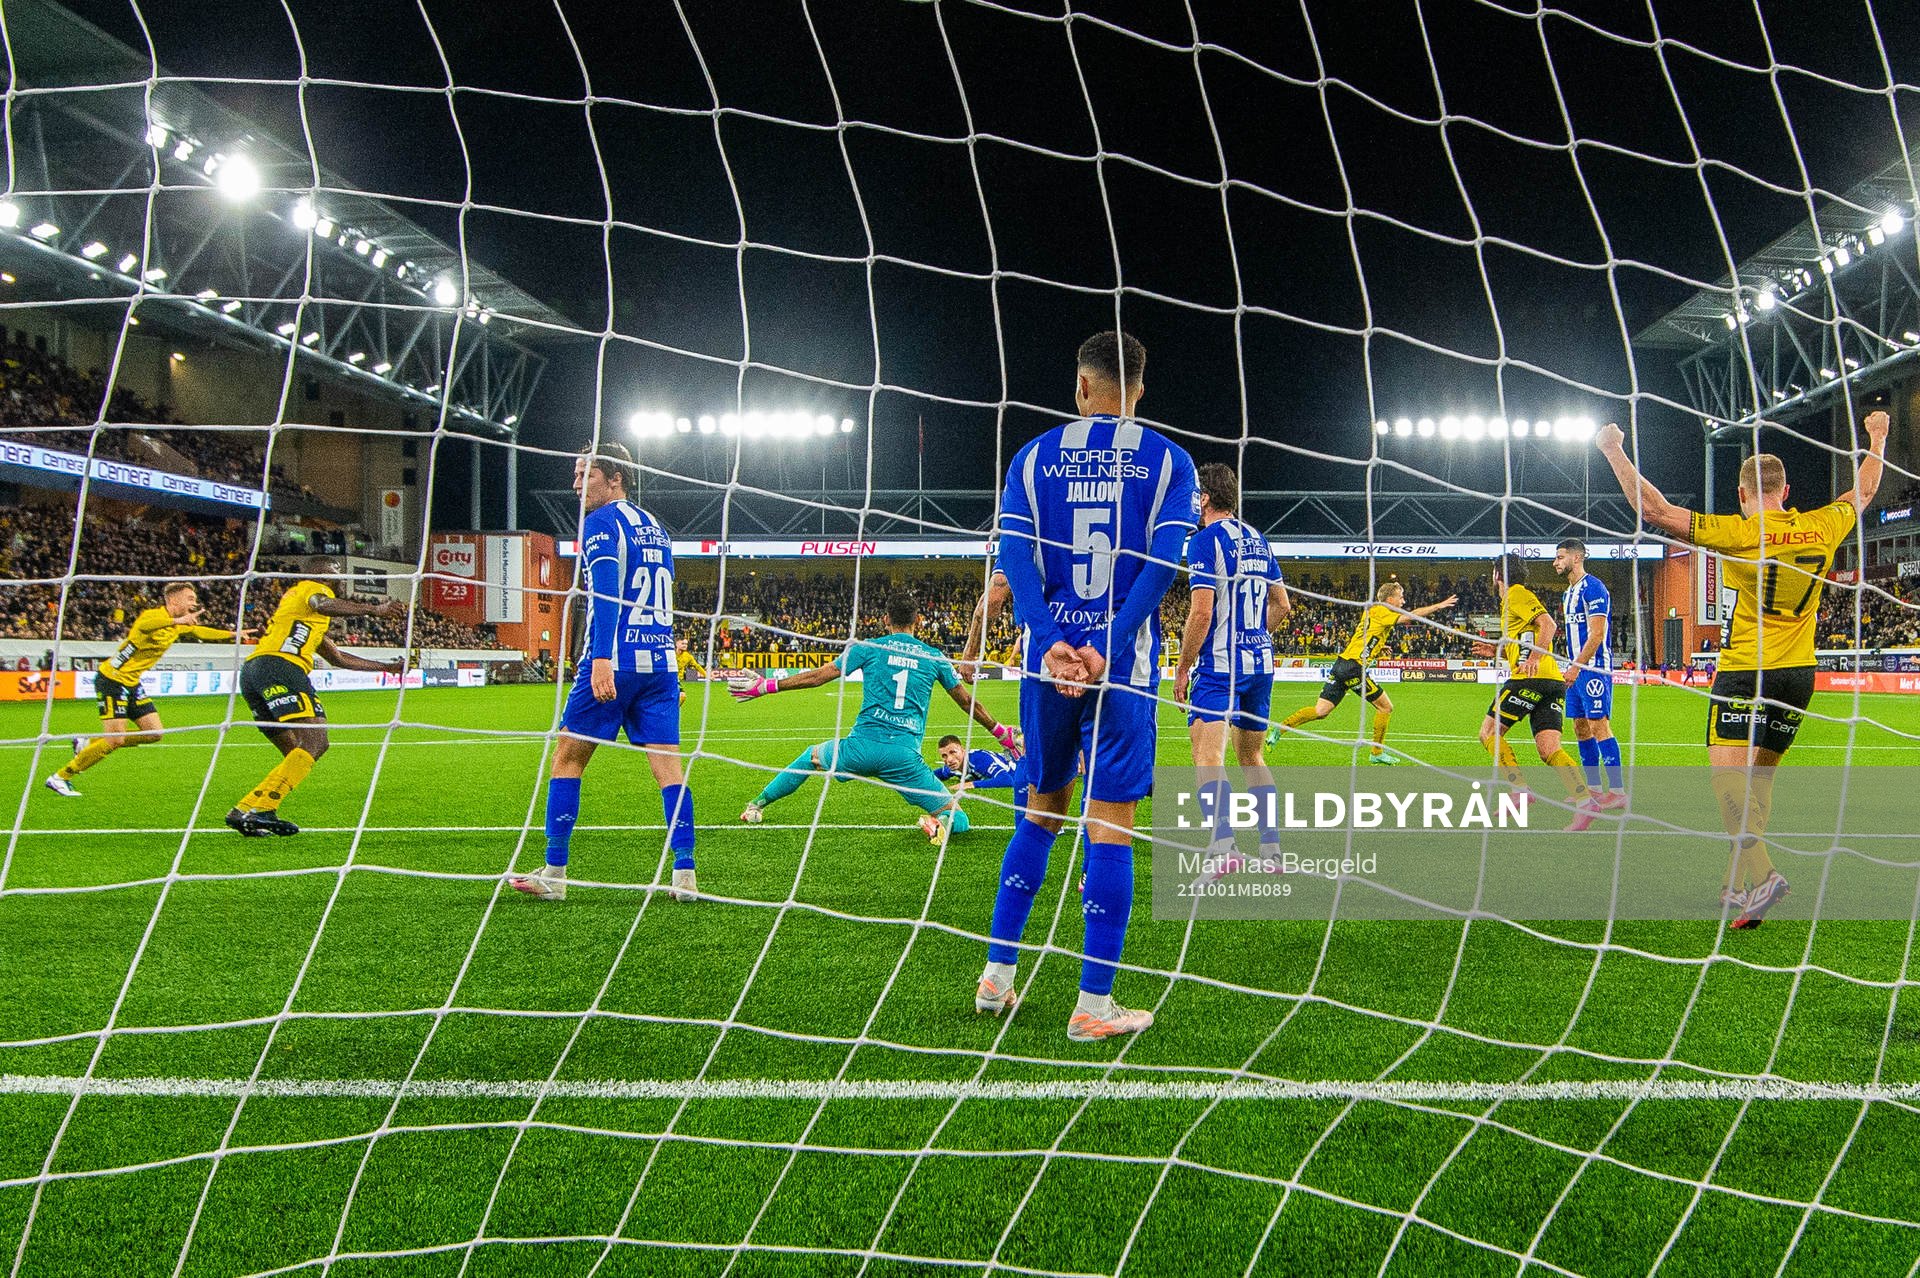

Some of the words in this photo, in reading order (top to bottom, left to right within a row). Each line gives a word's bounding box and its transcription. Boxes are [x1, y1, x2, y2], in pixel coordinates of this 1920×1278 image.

[1060, 450, 1133, 463] NORDIC
[1042, 465, 1150, 479] WELLNESS
[1066, 481, 1124, 502] JALLOW
[801, 542, 877, 555] PULSEN
[1763, 531, 1825, 546] PULSEN
[1072, 508, 1112, 600] 5
[1342, 545, 1413, 554] TOVEKS
[1416, 545, 1439, 554] BIL
[628, 567, 673, 626] 20
[1762, 555, 1827, 617] 17
[1240, 578, 1267, 630] 13
[892, 669, 909, 710] 1
